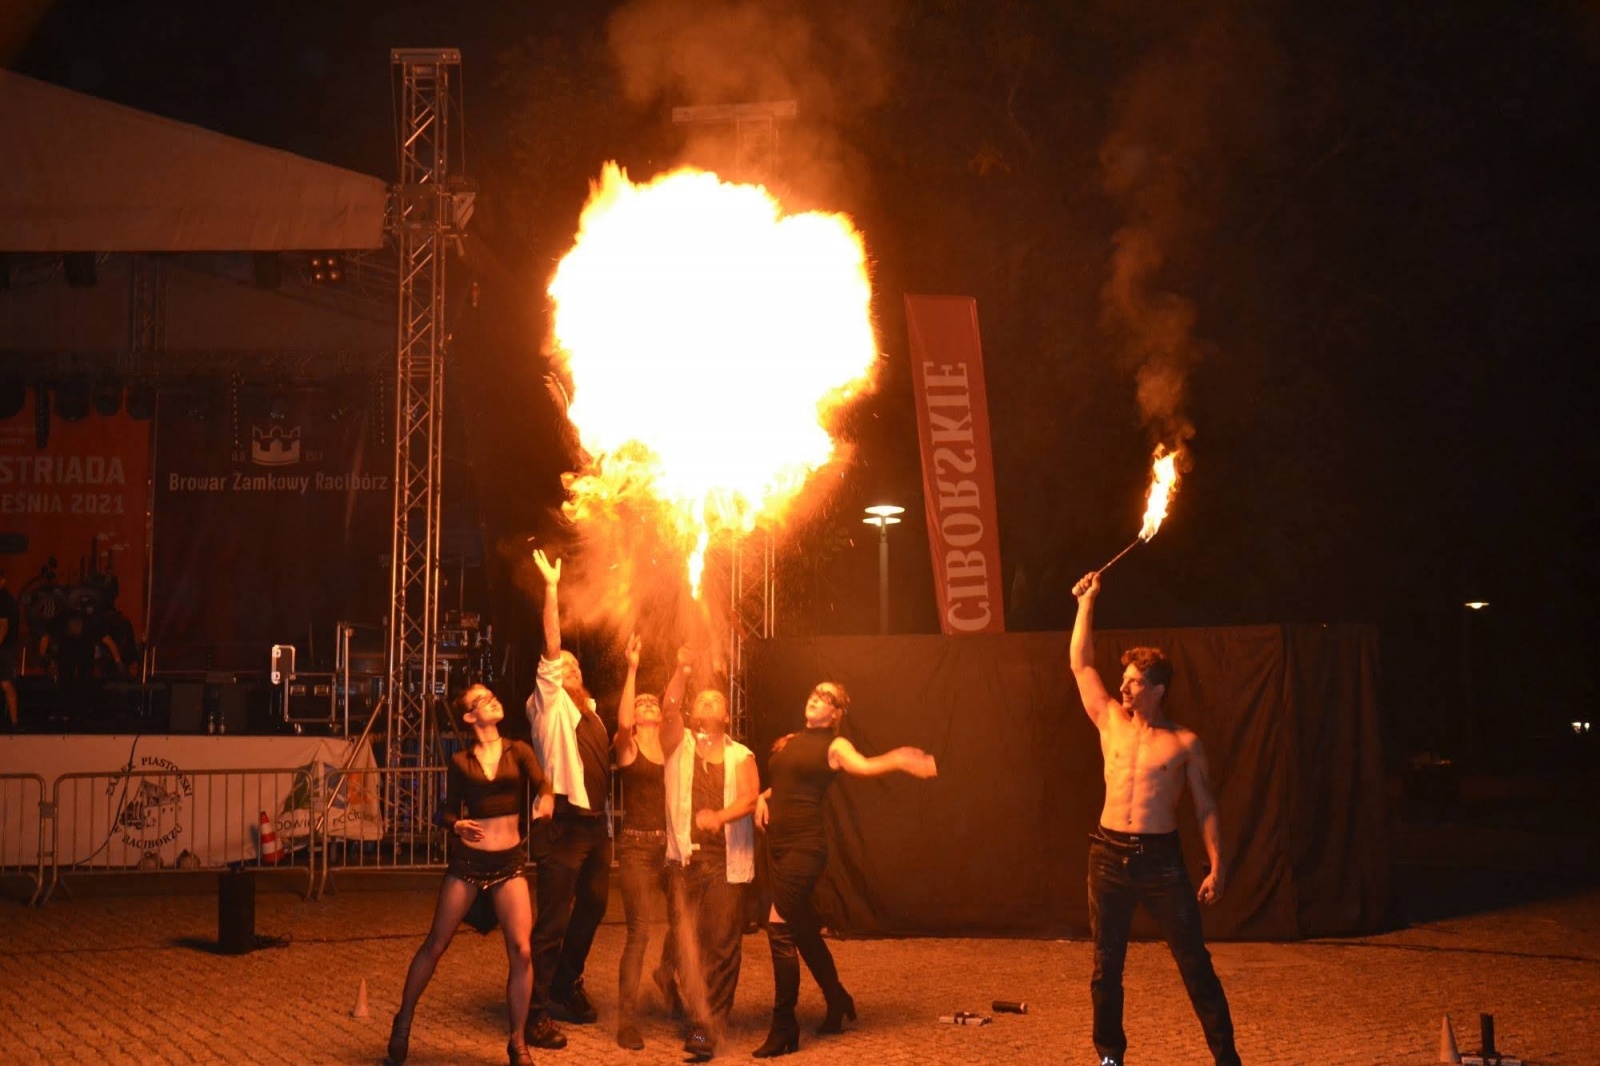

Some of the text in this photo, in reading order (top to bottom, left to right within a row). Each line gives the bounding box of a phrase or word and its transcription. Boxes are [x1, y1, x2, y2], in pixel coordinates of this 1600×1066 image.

[0, 455, 126, 485] STRIADA
[169, 472, 388, 494] Browar Zamkowy Racibórz
[70, 493, 125, 514] 2021
